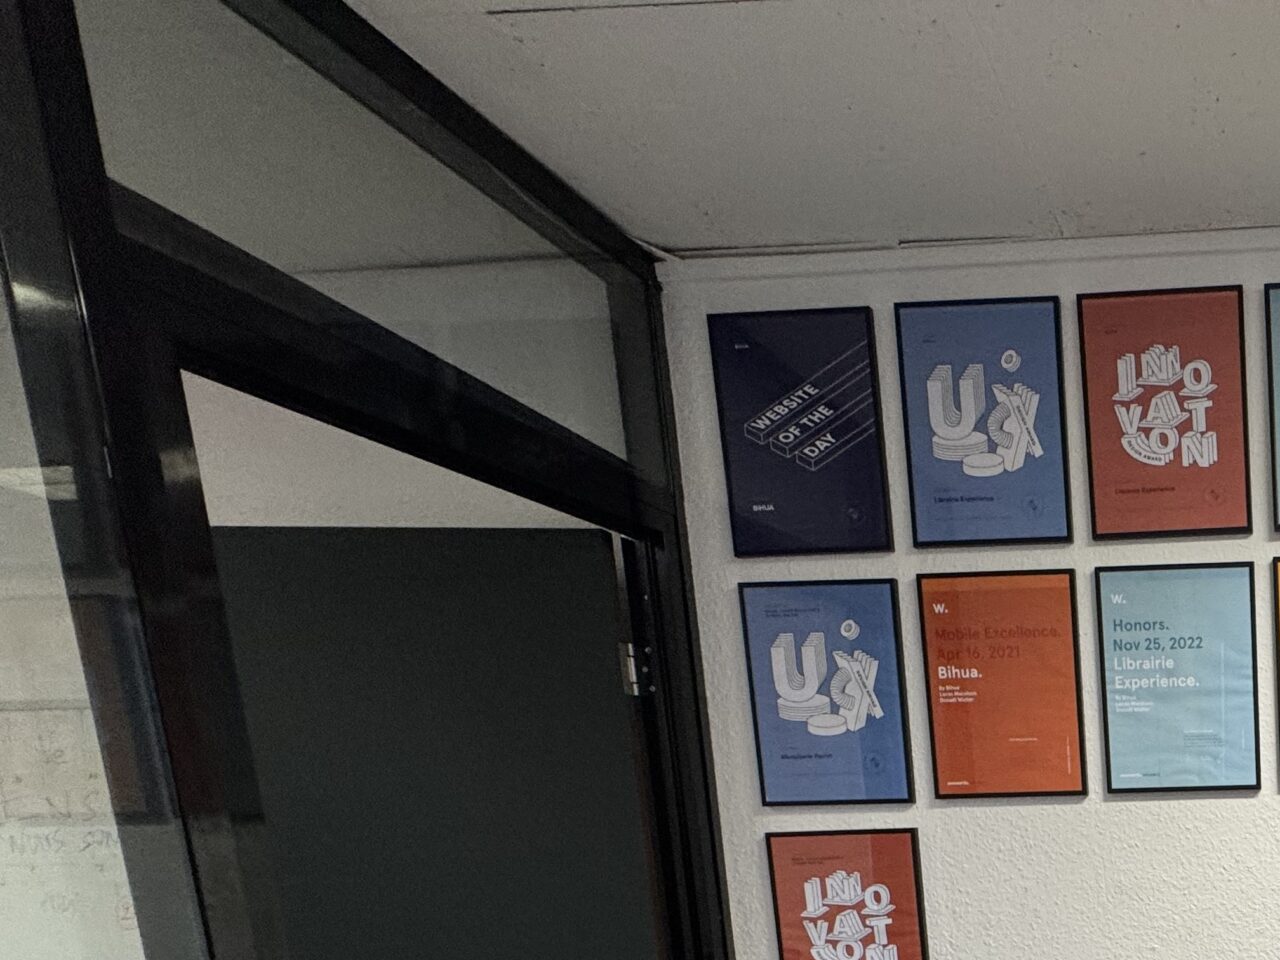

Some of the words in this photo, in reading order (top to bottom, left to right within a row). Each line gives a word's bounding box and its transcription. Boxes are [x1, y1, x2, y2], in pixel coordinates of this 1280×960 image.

[751, 383, 820, 430] WEBSITE
[778, 423, 803, 444] OF
[799, 405, 834, 431] THE
[802, 432, 838, 459] DAY
[935, 628, 980, 641] Mobile
[984, 625, 1061, 639] Excellence.
[1113, 619, 1169, 632] Honors.
[1113, 638, 1141, 652] Nov
[1145, 637, 1166, 652] 25,
[1169, 636, 1204, 650] 2022
[937, 648, 961, 663] Apr
[990, 645, 1020, 659] 2021
[1114, 656, 1174, 671] Librairie
[938, 666, 982, 679] Bihua.
[1115, 675, 1200, 691] Experience.
